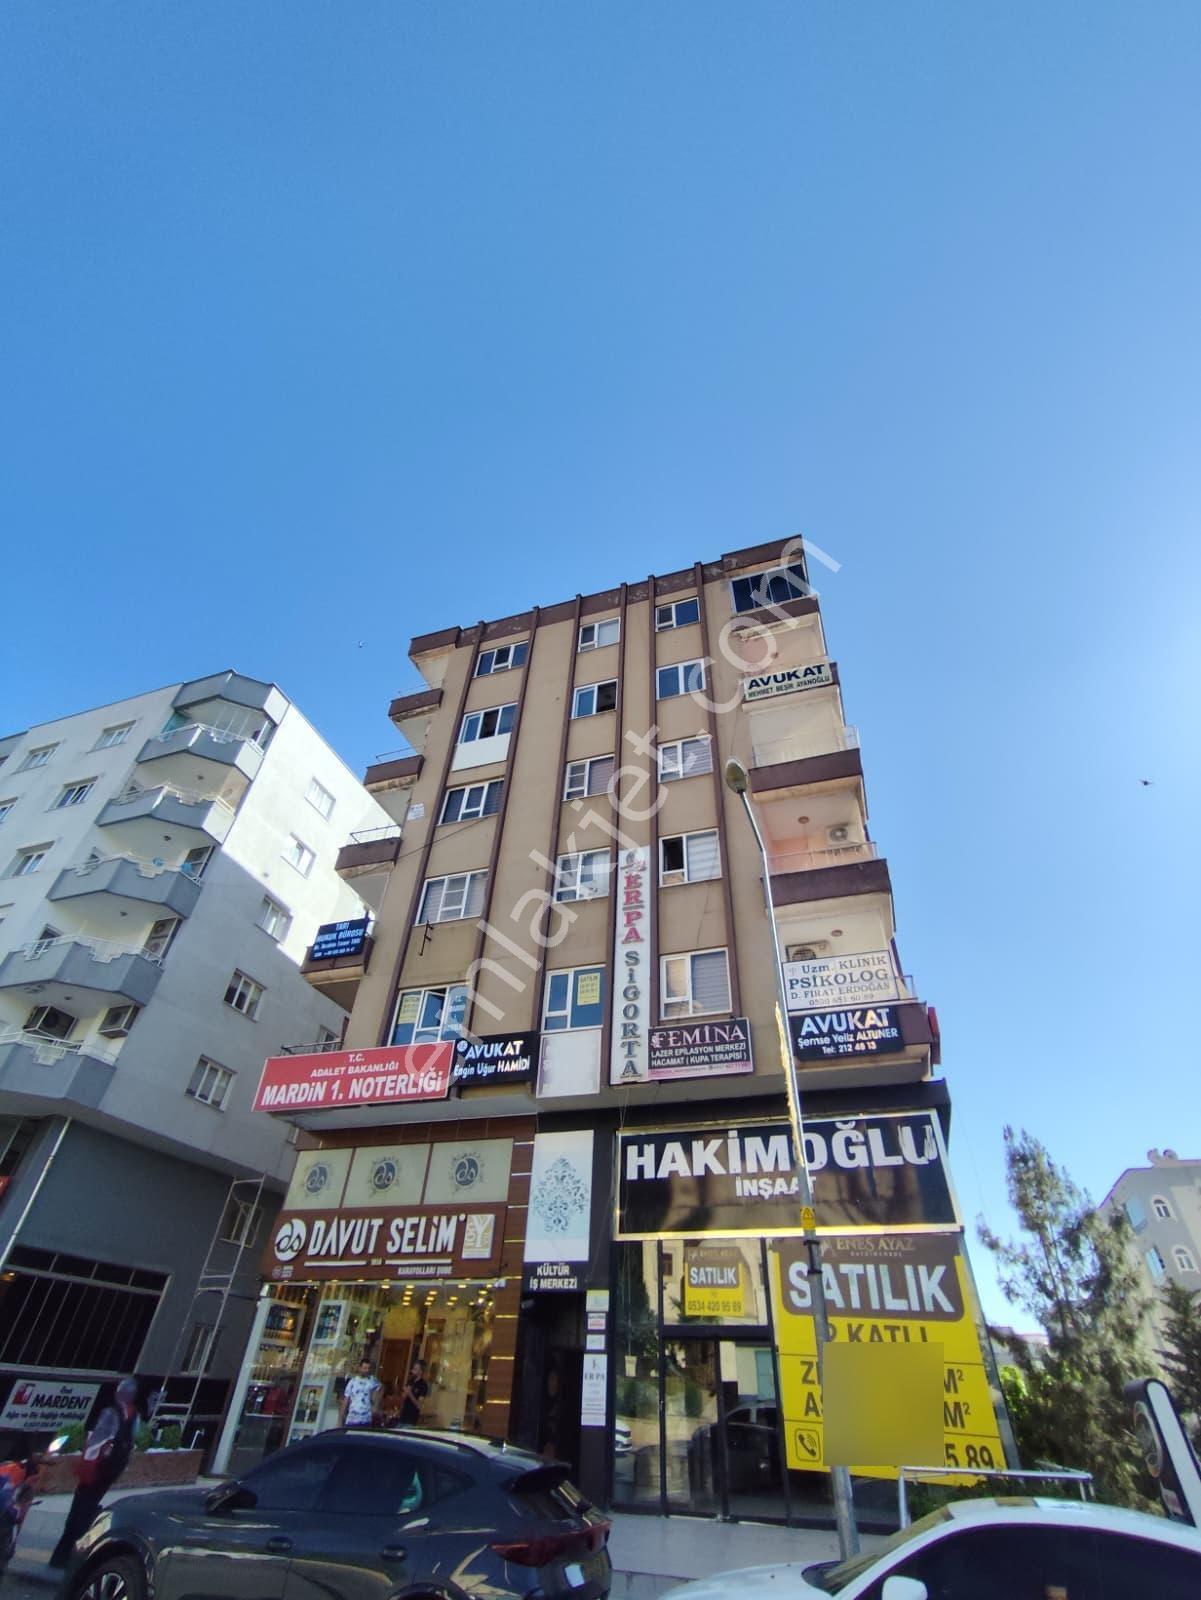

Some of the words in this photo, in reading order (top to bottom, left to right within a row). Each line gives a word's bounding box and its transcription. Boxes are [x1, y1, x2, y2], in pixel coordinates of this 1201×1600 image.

[748, 664, 825, 689] AVUKAT
[748, 687, 773, 698] MEHMET
[839, 955, 887, 970] KLİNİK
[789, 969, 888, 990] PSİKOLOG
[804, 988, 834, 999] FIRAT
[839, 982, 891, 996] ERDOĞAN
[801, 1008, 889, 1036] AVUKAT
[650, 1025, 746, 1048] FEMİNA
[797, 1036, 830, 1049] Şemse
[856, 1028, 898, 1042] ALTUNER
[465, 1040, 524, 1060] AVUKAT
[651, 1049, 673, 1058] LAZER
[675, 1045, 713, 1056] EPİLASYON
[715, 1041, 746, 1052] MERKEZİ
[838, 1044, 853, 1053] 212
[349, 1054, 364, 1062] T.C.
[651, 1057, 684, 1067] HACAMAT
[310, 1067, 346, 1078] ADALET
[348, 1061, 398, 1075] BAKANLIĞI
[477, 1062, 496, 1077] Uğur
[331, 1081, 343, 1099] 1.
[626, 1120, 939, 1182] HAKİMOĞLU
[307, 1217, 384, 1259] DAVUT
[836, 1238, 875, 1250] ENES
[878, 1237, 917, 1250] AYAZ
[537, 1263, 570, 1275] KÜLTÜR
[690, 1266, 737, 1285] SATILIK
[529, 1278, 538, 1290] İŞ
[540, 1277, 577, 1290] MERKEZİ
[788, 1261, 956, 1313] SATILIK
[31, 1394, 93, 1410] MARDENT
